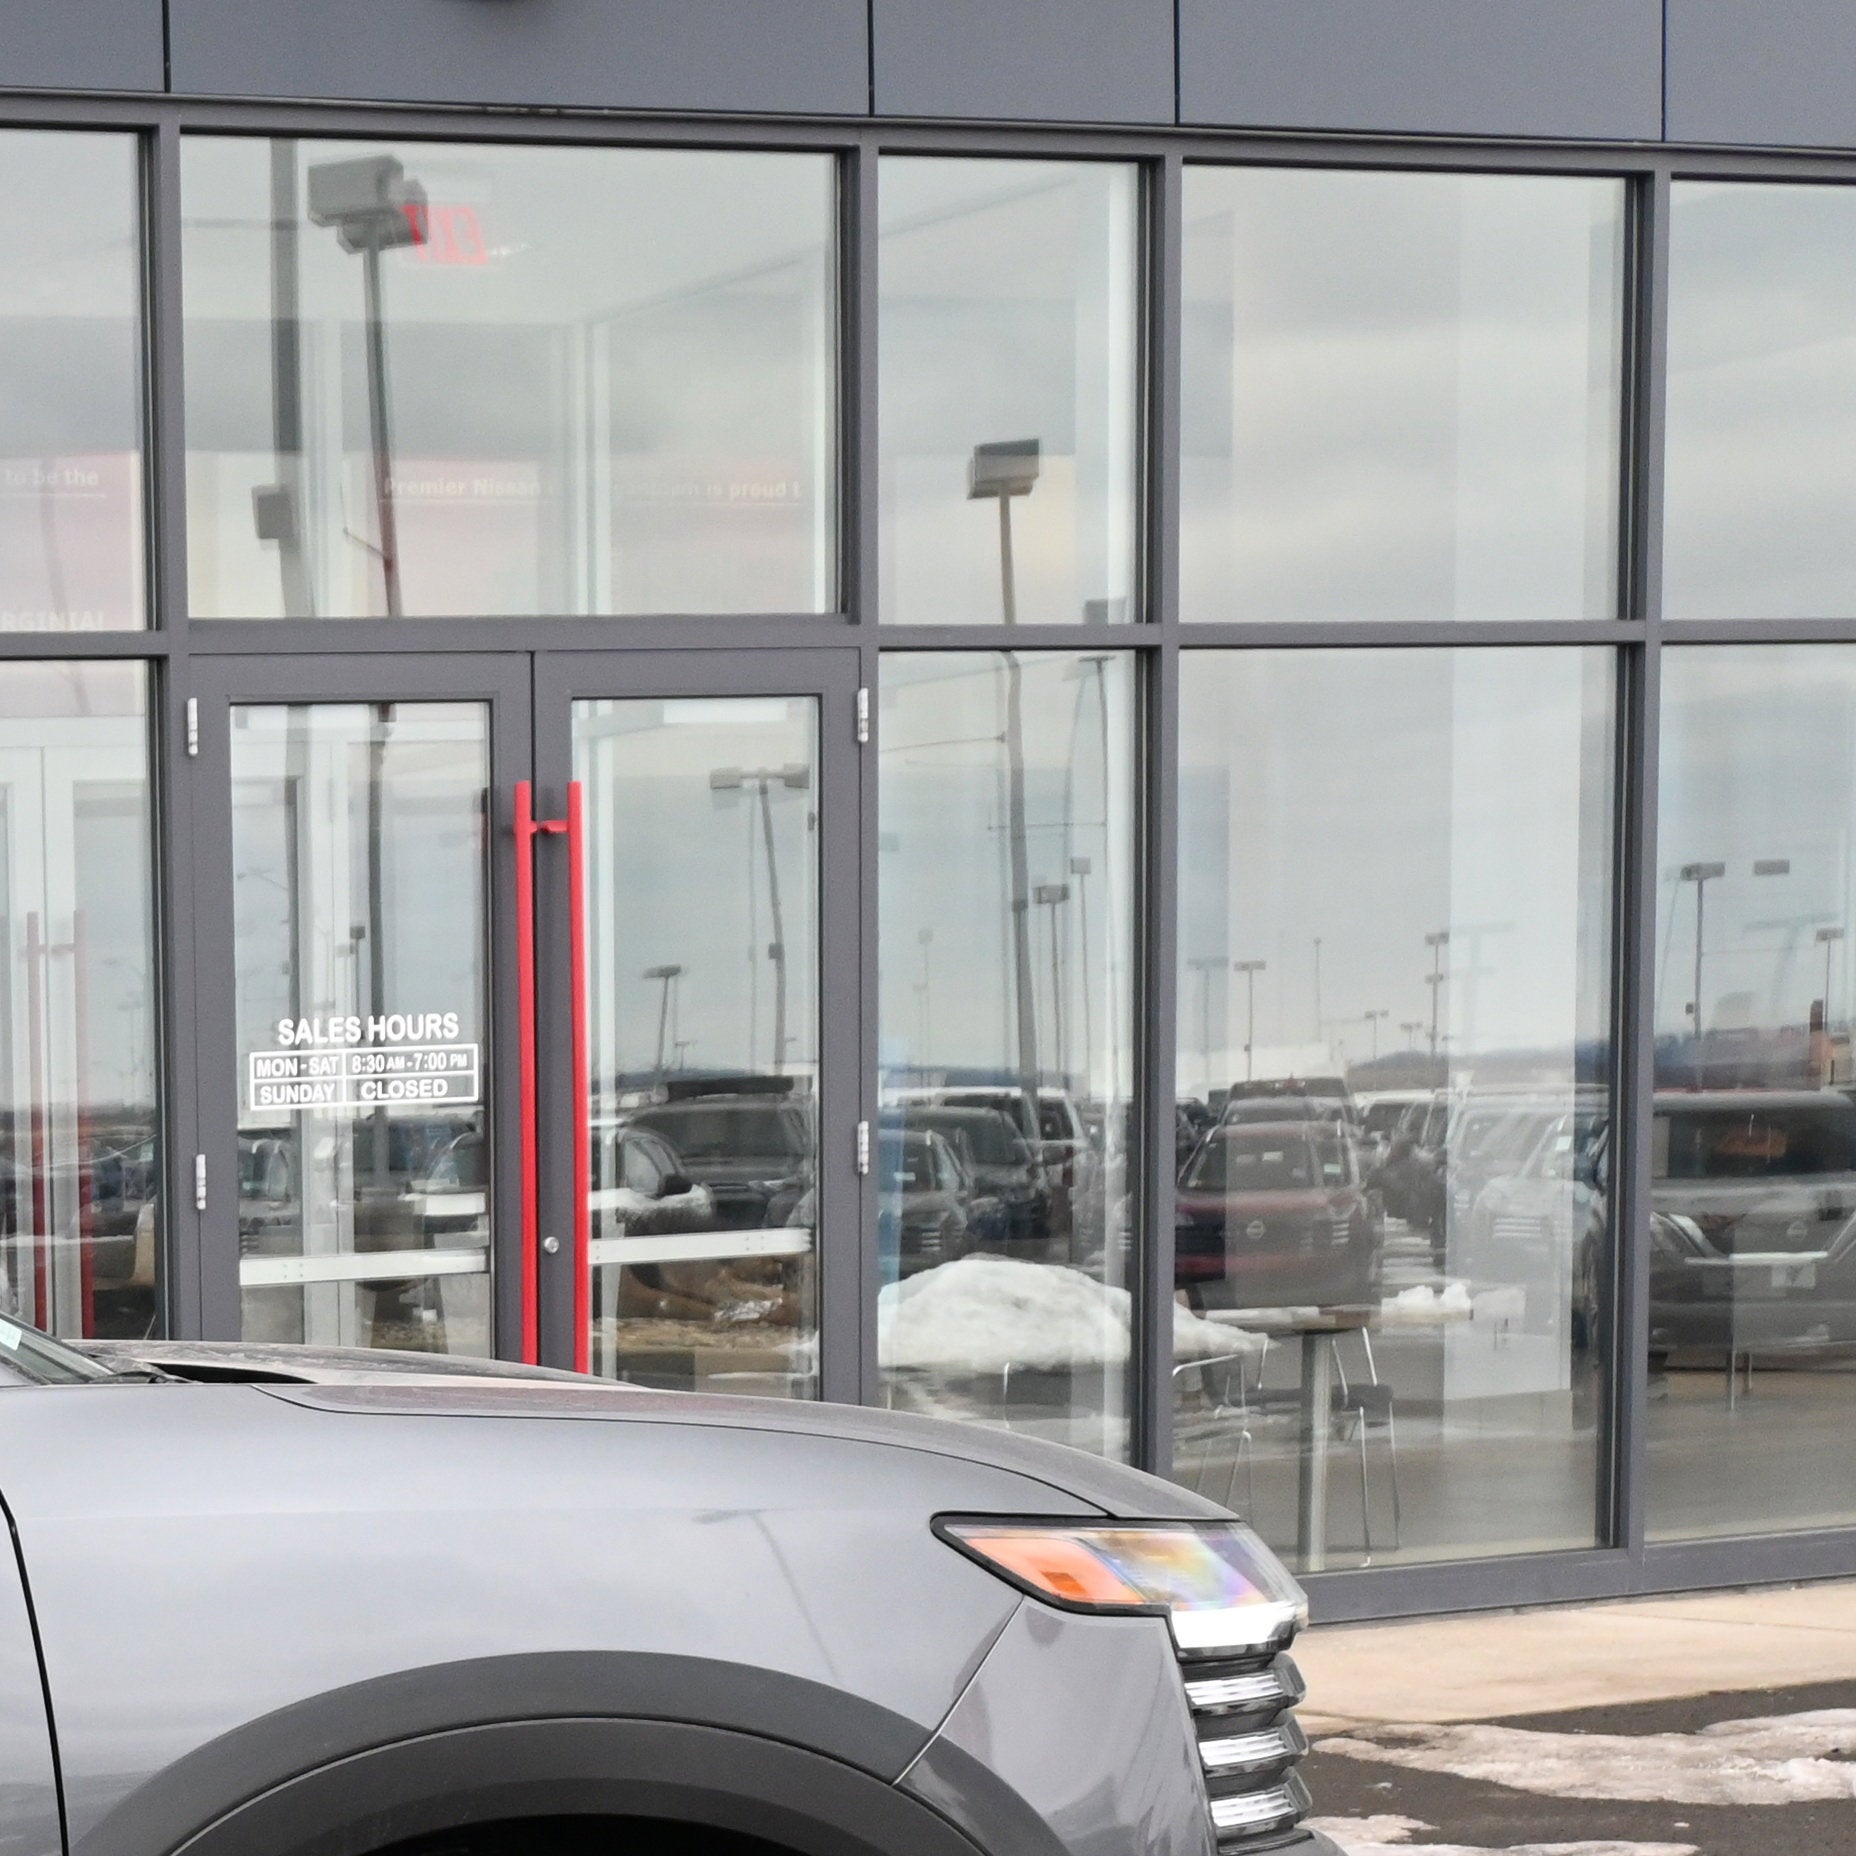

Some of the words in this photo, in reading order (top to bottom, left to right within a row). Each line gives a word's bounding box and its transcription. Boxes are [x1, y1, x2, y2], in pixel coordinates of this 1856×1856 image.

[63, 466, 99, 487] the
[728, 477, 787, 500] proud
[278, 1016, 362, 1046] SALES
[368, 1012, 460, 1043] HOURS
[351, 1055, 385, 1074] 8:30
[449, 1053, 468, 1069] PM
[260, 1083, 336, 1104] SUNDAY
[360, 1079, 449, 1100] CLOSED
